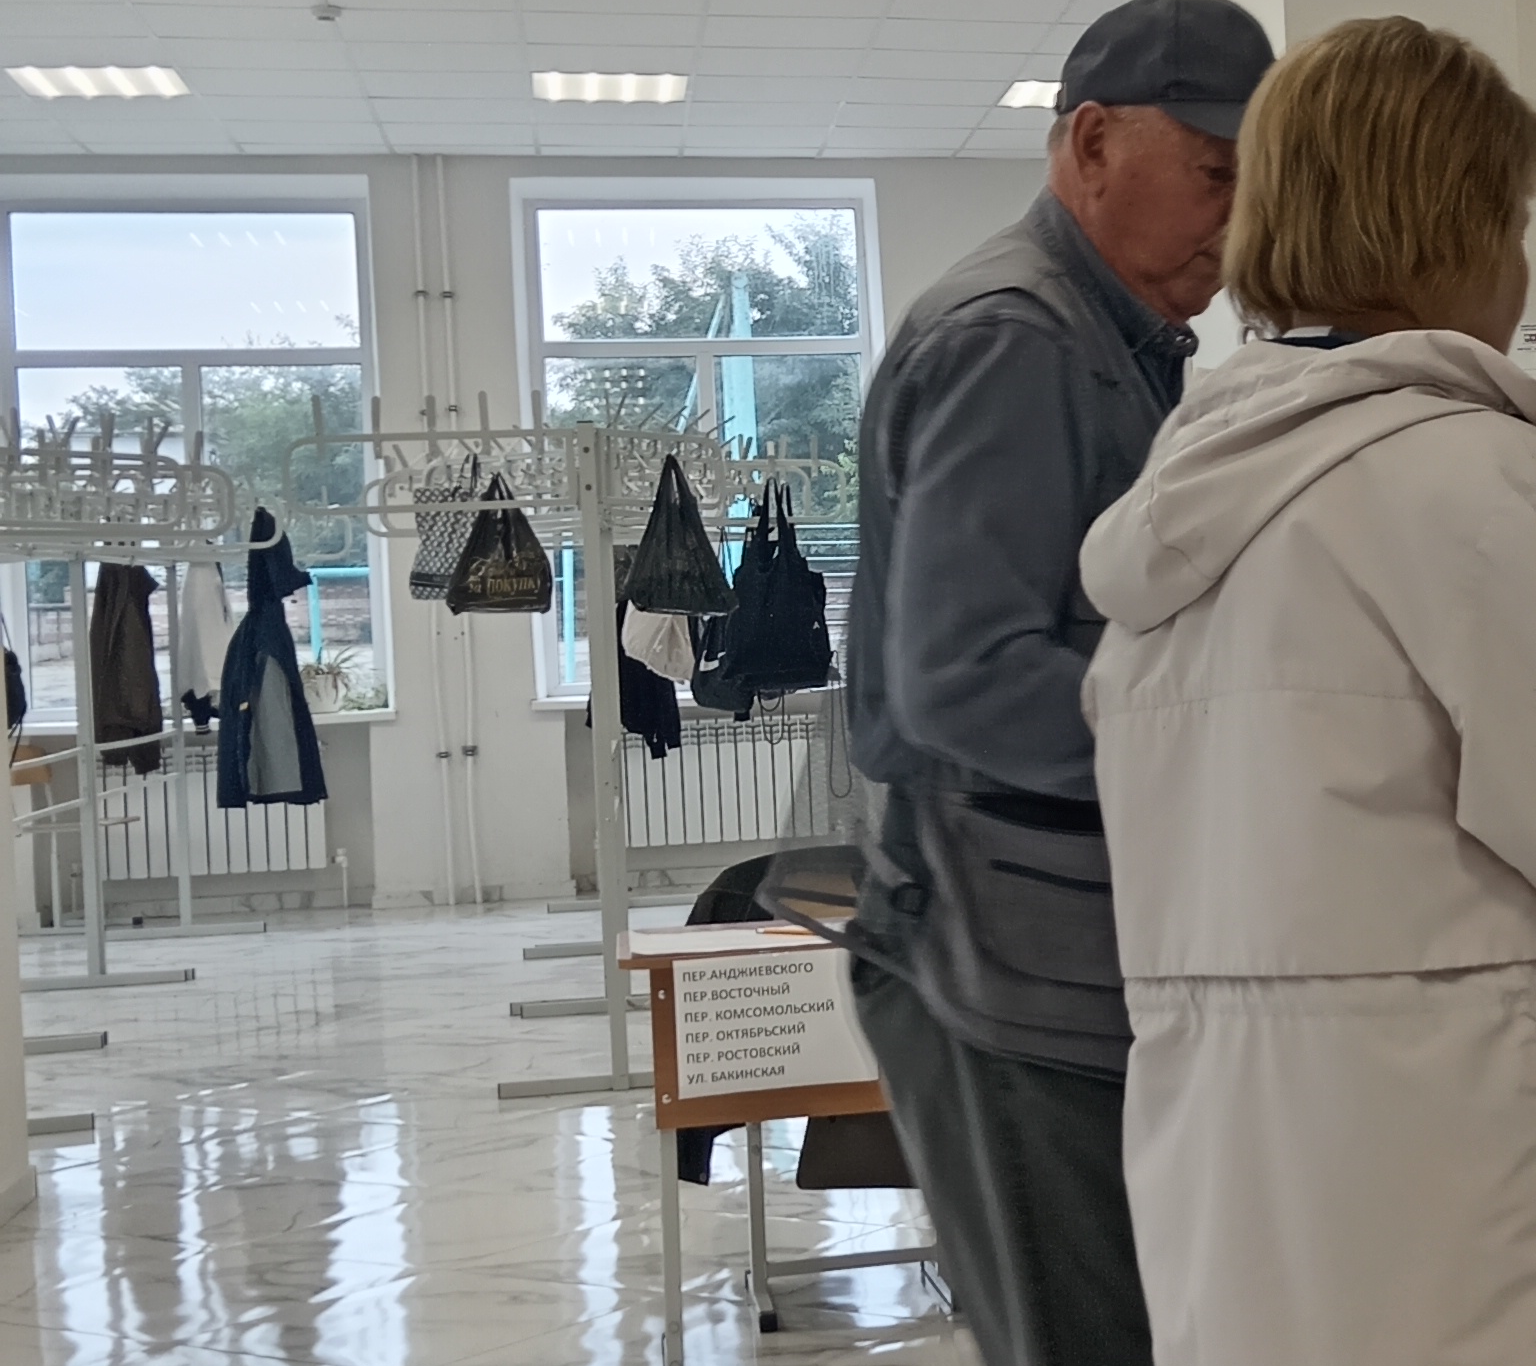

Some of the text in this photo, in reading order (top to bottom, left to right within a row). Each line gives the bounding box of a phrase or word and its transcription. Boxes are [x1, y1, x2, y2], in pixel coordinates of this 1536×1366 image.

[682, 962, 814, 982] ПЕР.АНДЖИЕВСКОГО
[683, 982, 791, 1003] ПЕР.ВОСТОЧНЫЙ
[684, 999, 835, 1023] ПЕР. КОМСОМОЛЬСКИЙ
[685, 1021, 806, 1043] ПЕР. ОКТЯБРЬСКИЙ
[686, 1042, 801, 1064] ПЕР. РОСТОВСКИЙ
[687, 1065, 786, 1085] УЛ. БАКИНСКАЯ
